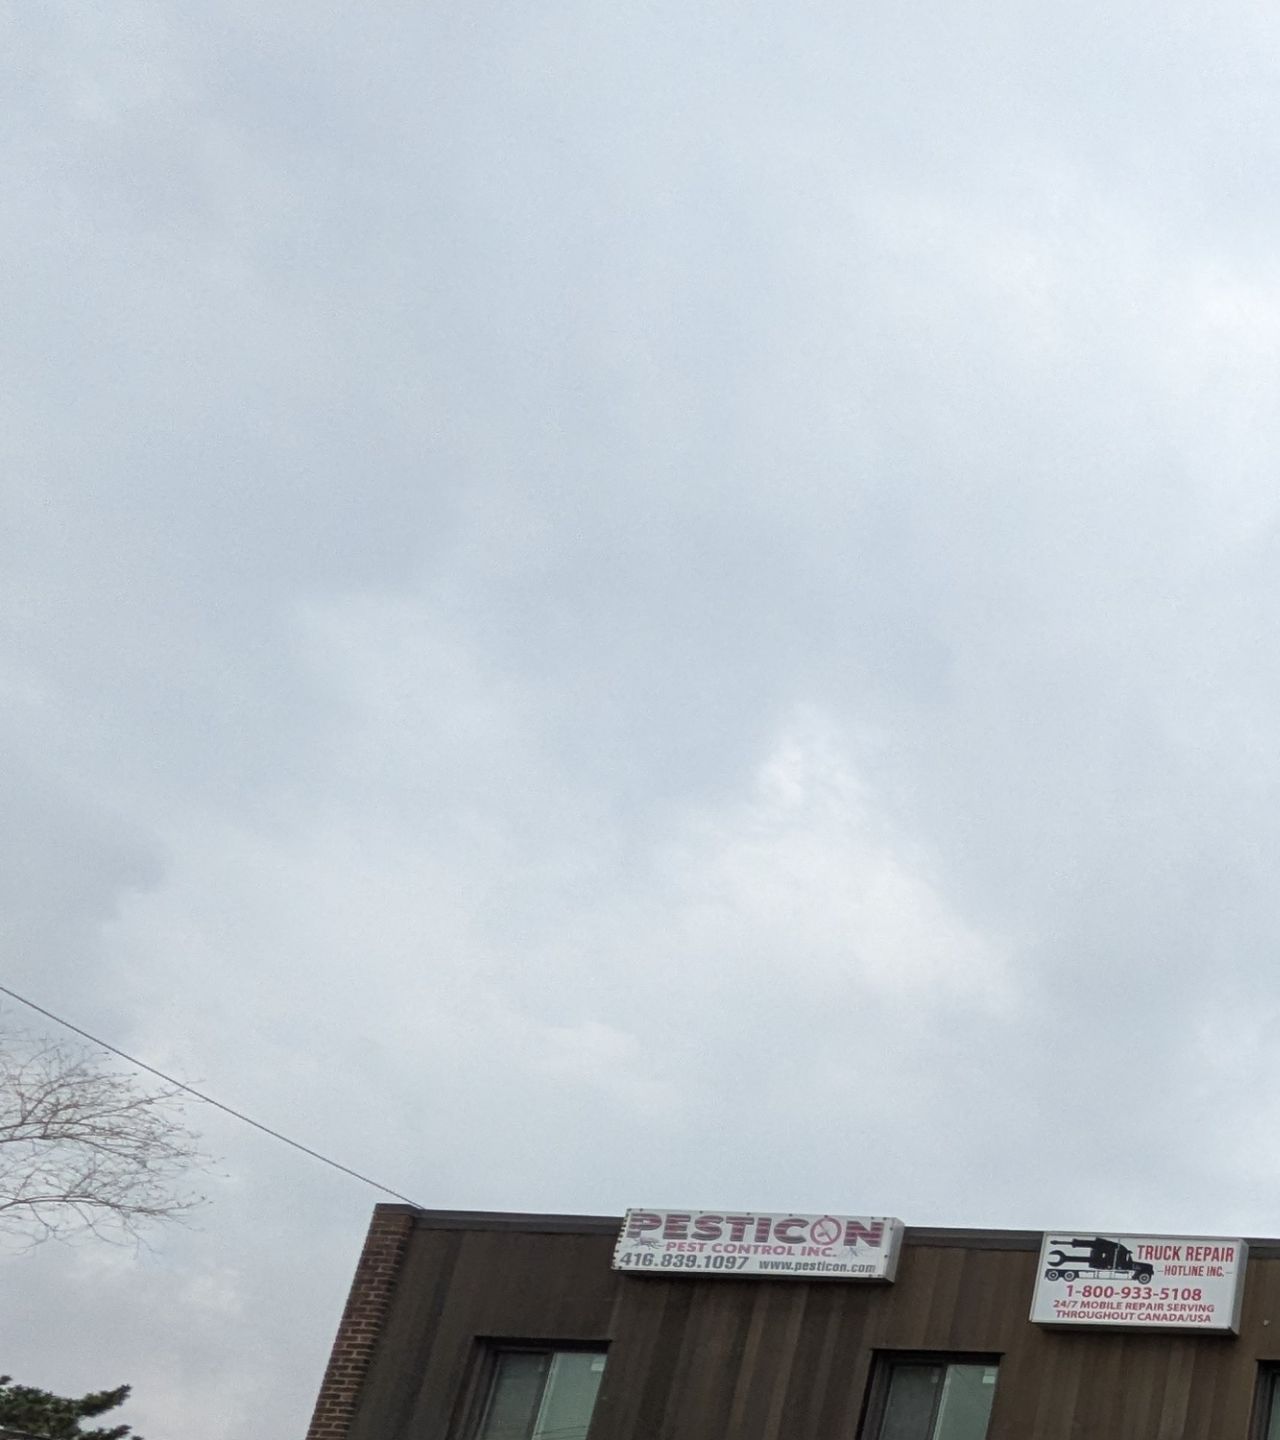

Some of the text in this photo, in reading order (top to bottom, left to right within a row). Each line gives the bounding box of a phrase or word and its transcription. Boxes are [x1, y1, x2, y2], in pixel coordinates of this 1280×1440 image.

[626, 1213, 884, 1247] PESTICON
[665, 1241, 837, 1257] PEST CONTROL INC.
[1137, 1245, 1234, 1262] TRUCK REPAIR
[620, 1252, 876, 1273] 416.839.1097 www.pesticon.com
[1164, 1265, 1225, 1277] HOTLINE INC.
[1066, 1285, 1202, 1300] 1-800-933-5108
[1053, 1300, 1214, 1313] 24/7 MOBILE REPAIR SERVING
[1056, 1310, 1211, 1323] THROUGHOUT CANADA/USA
